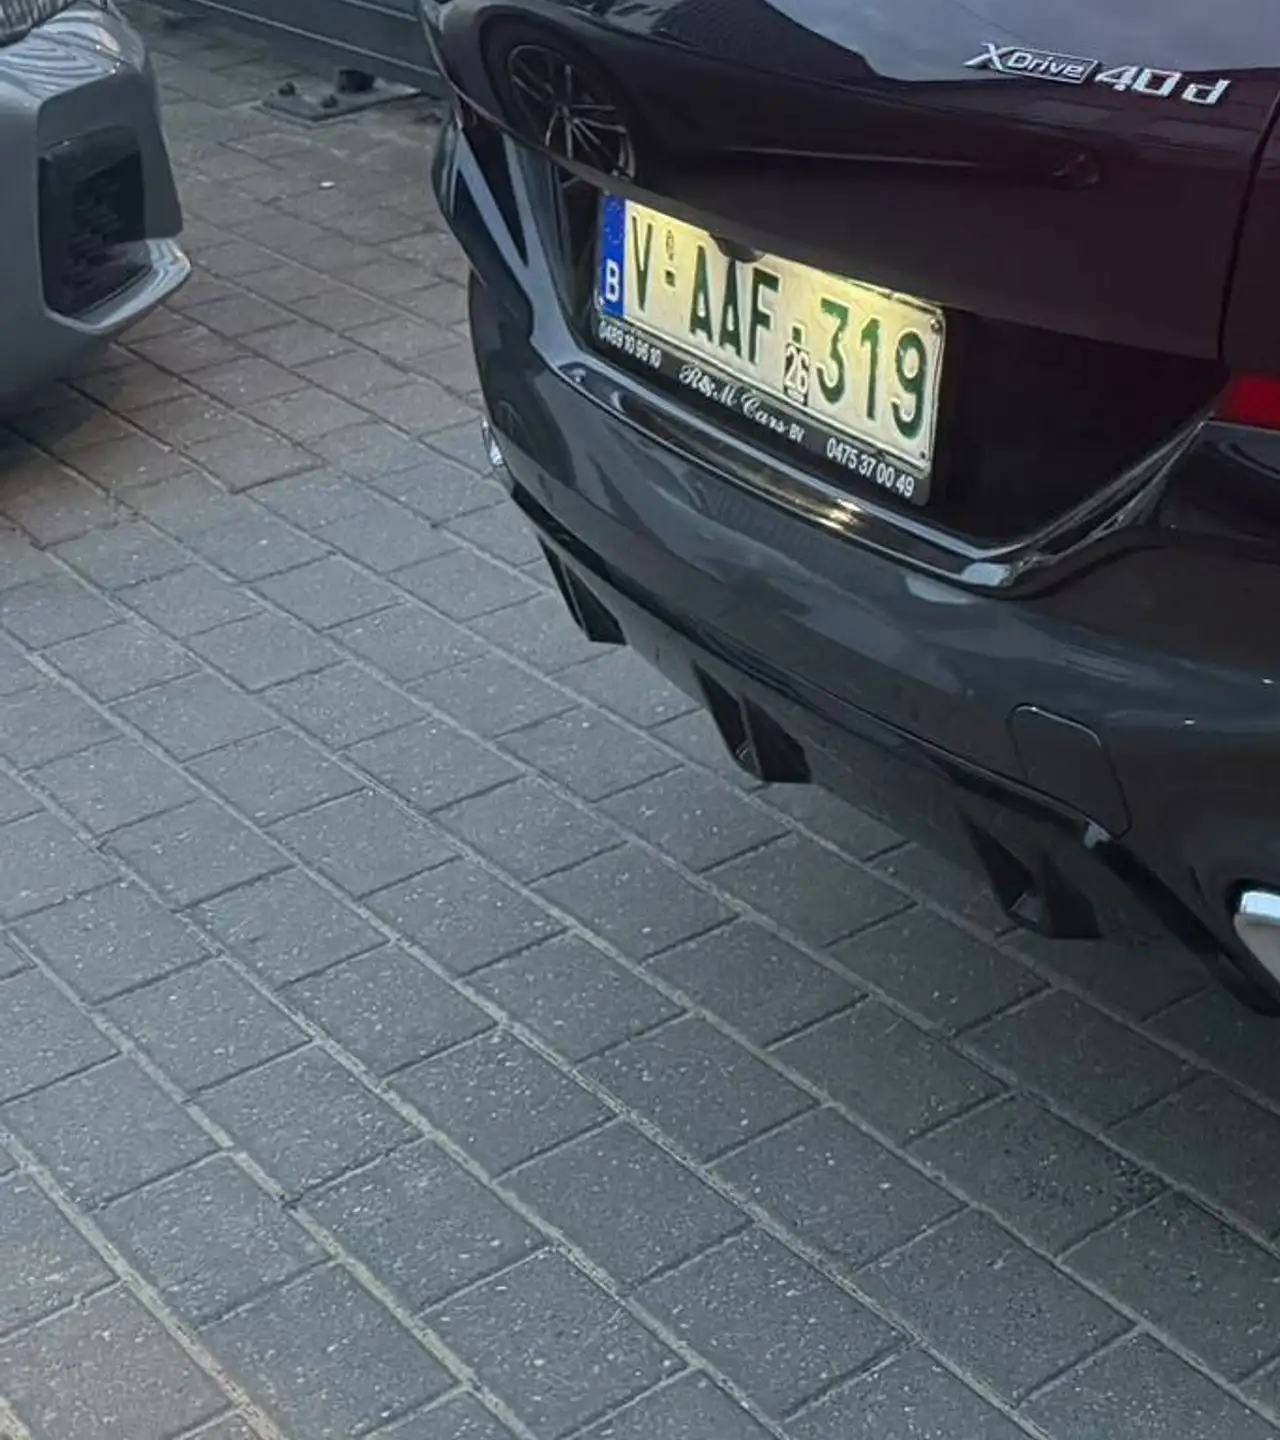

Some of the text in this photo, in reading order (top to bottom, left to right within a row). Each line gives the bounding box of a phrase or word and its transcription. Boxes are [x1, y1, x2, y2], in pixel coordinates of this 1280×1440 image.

[605, 261, 620, 303] B
[740, 388, 788, 433] Cars
[827, 437, 858, 469] 0475
[858, 454, 877, 477] 37
[876, 463, 895, 488] 00
[895, 473, 915, 498] 49
